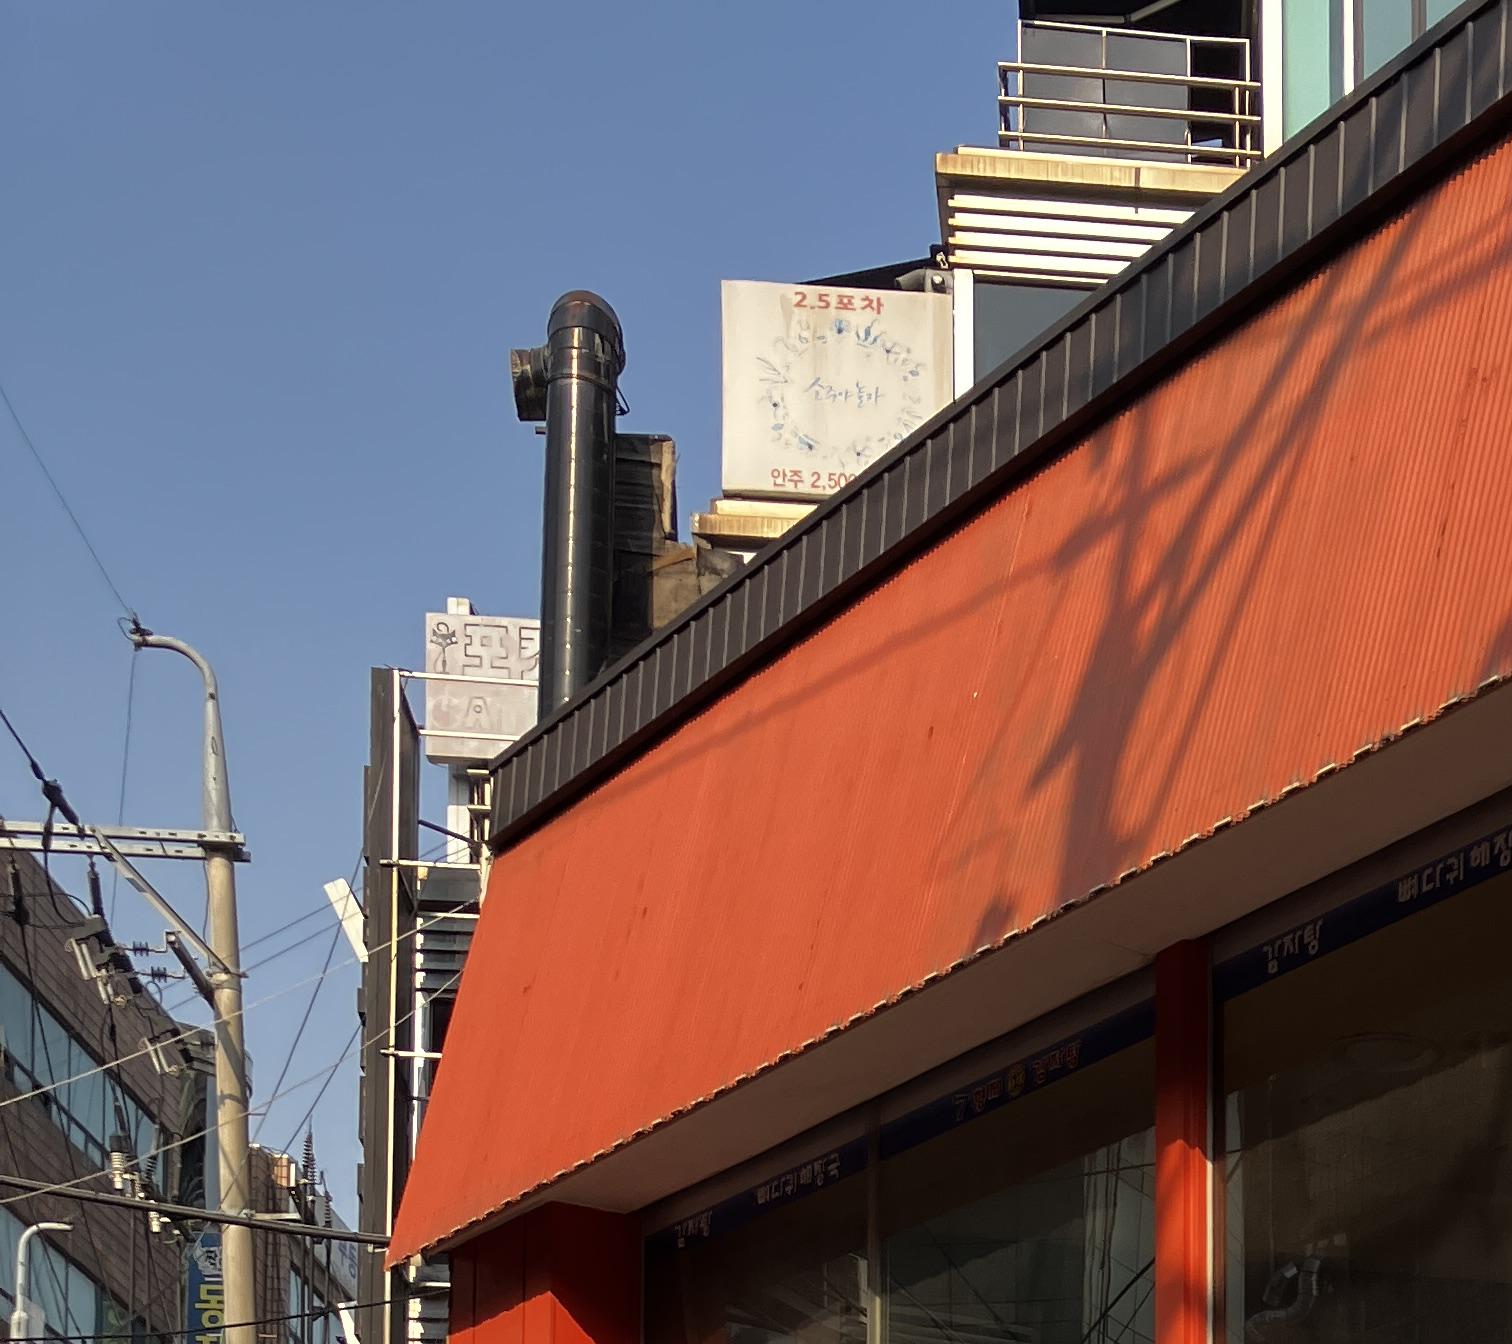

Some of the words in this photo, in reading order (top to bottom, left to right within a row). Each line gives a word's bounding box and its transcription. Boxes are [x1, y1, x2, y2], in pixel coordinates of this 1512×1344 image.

[793, 291, 885, 315] 2.5포차
[770, 468, 804, 488] 안주
[1262, 918, 1324, 975] 감자탕
